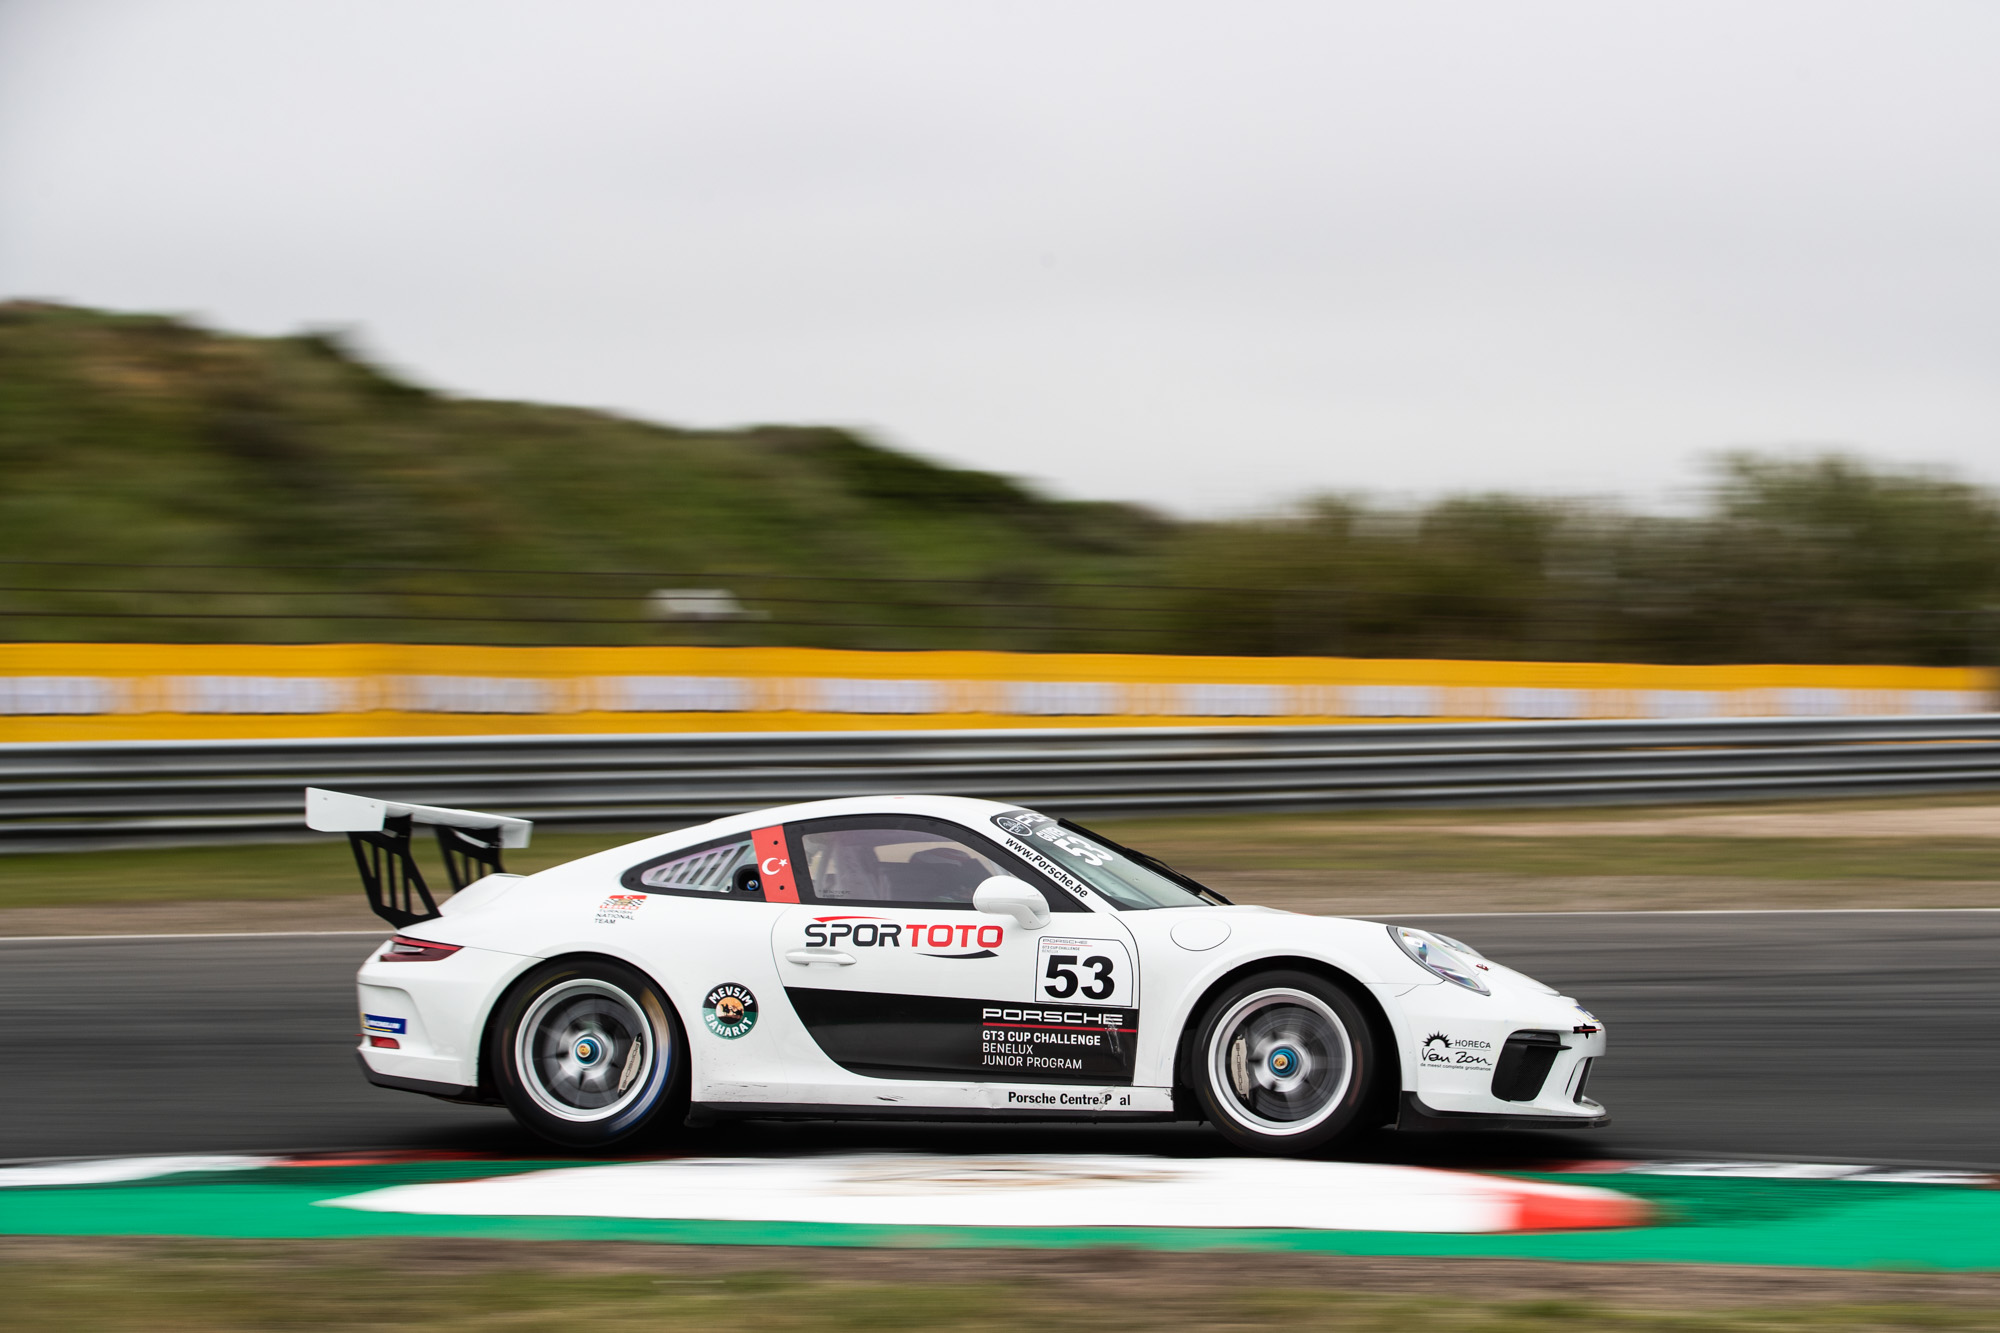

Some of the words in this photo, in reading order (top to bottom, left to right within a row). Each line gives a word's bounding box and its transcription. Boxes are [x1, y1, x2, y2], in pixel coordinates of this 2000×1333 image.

[1053, 836, 1114, 867] 53
[1005, 838, 1088, 898] www.Porsche.be
[1044, 954, 1115, 1000] 53
[982, 1008, 1123, 1026] PORSCHE
[705, 1014, 753, 1037] BAHARAT
[982, 1030, 1005, 1041] GT3
[1007, 1031, 1031, 1043] CUP
[1033, 1033, 1101, 1046] CHALLENGE
[1454, 1039, 1491, 1049] HORECA
[982, 1042, 1034, 1055] BENELUX
[1421, 1047, 1451, 1063] Van
[982, 1055, 1023, 1067] JUNIOR
[1026, 1057, 1083, 1070] PROGRAM
[1008, 1091, 1056, 1104] Porsche
[1060, 1093, 1099, 1105] Centre
